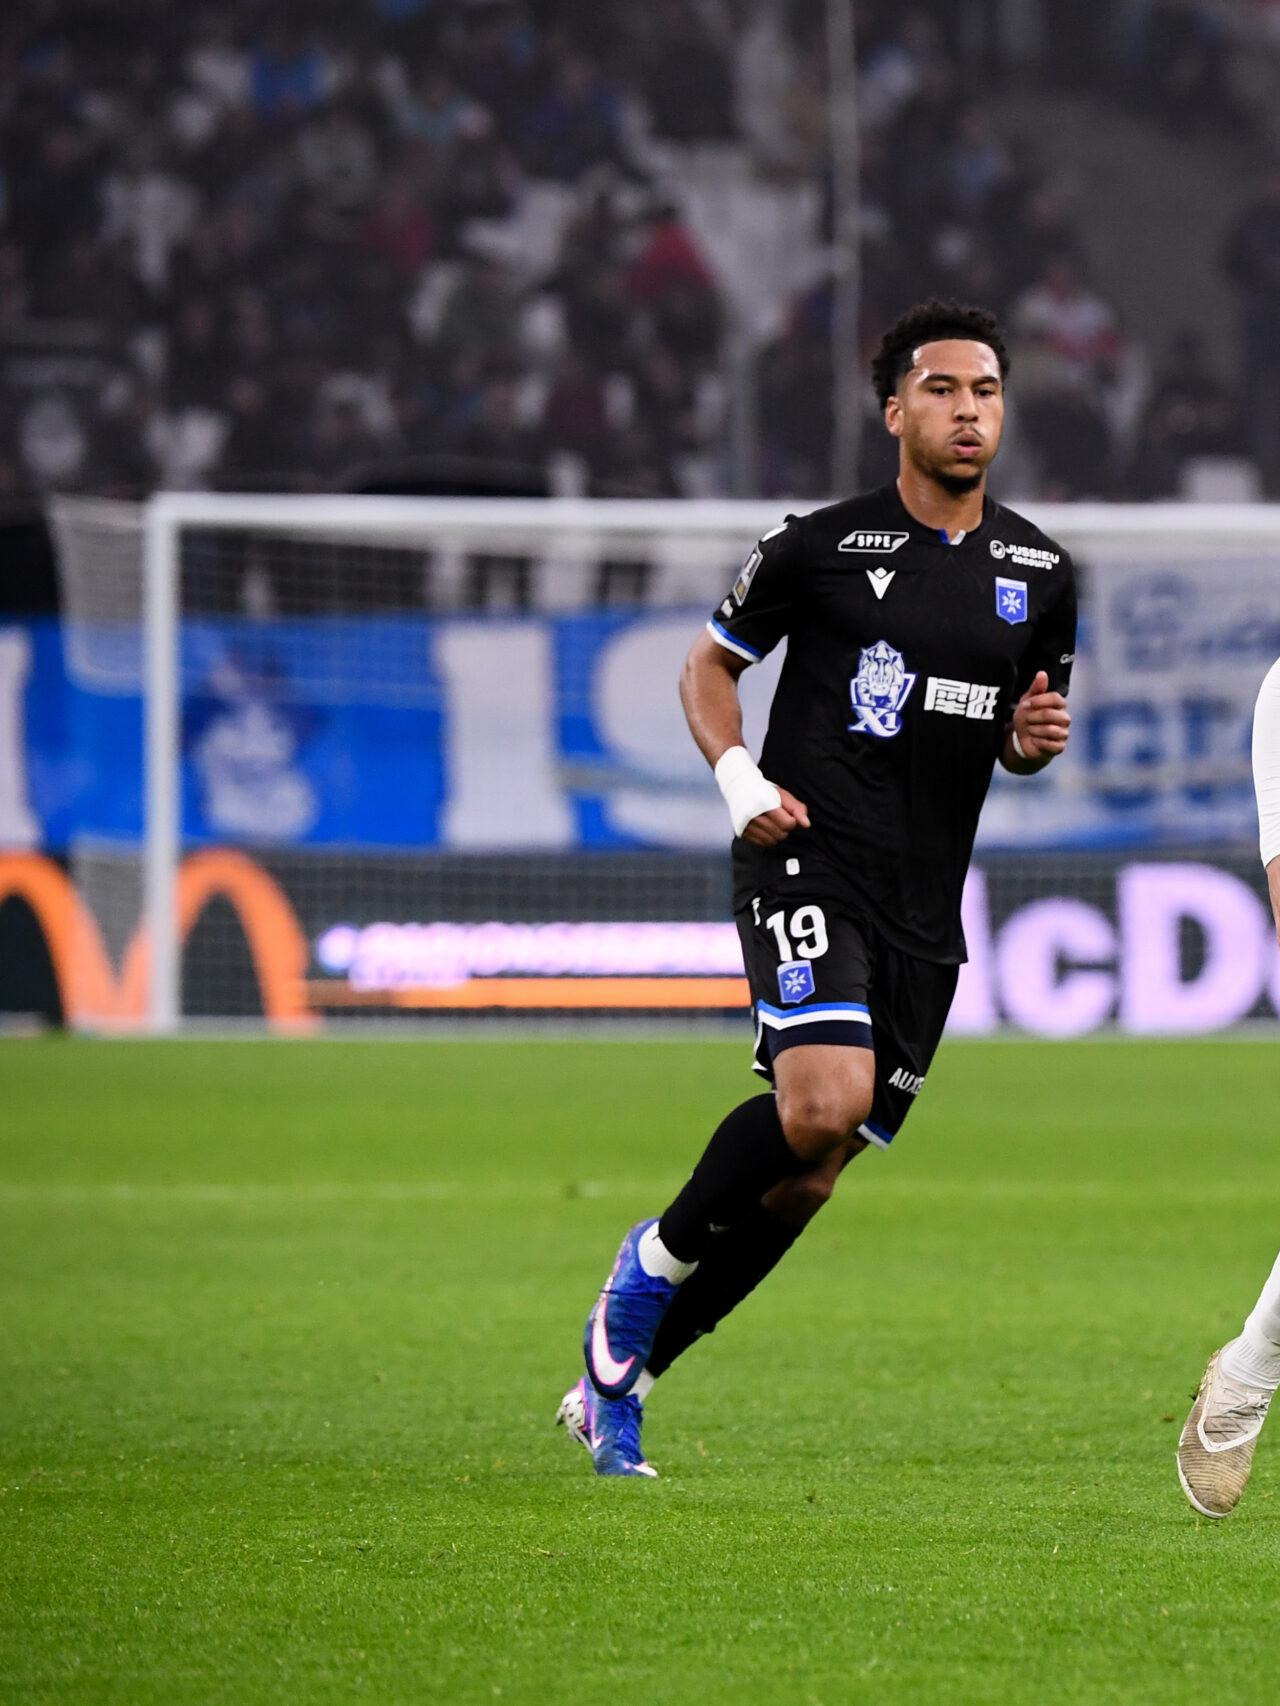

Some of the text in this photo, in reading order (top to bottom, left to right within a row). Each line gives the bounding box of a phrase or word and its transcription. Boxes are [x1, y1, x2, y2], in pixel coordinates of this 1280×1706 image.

[857, 534, 891, 548] SPPE
[1005, 544, 1060, 564] JUSSIEU
[766, 905, 829, 962] 19
